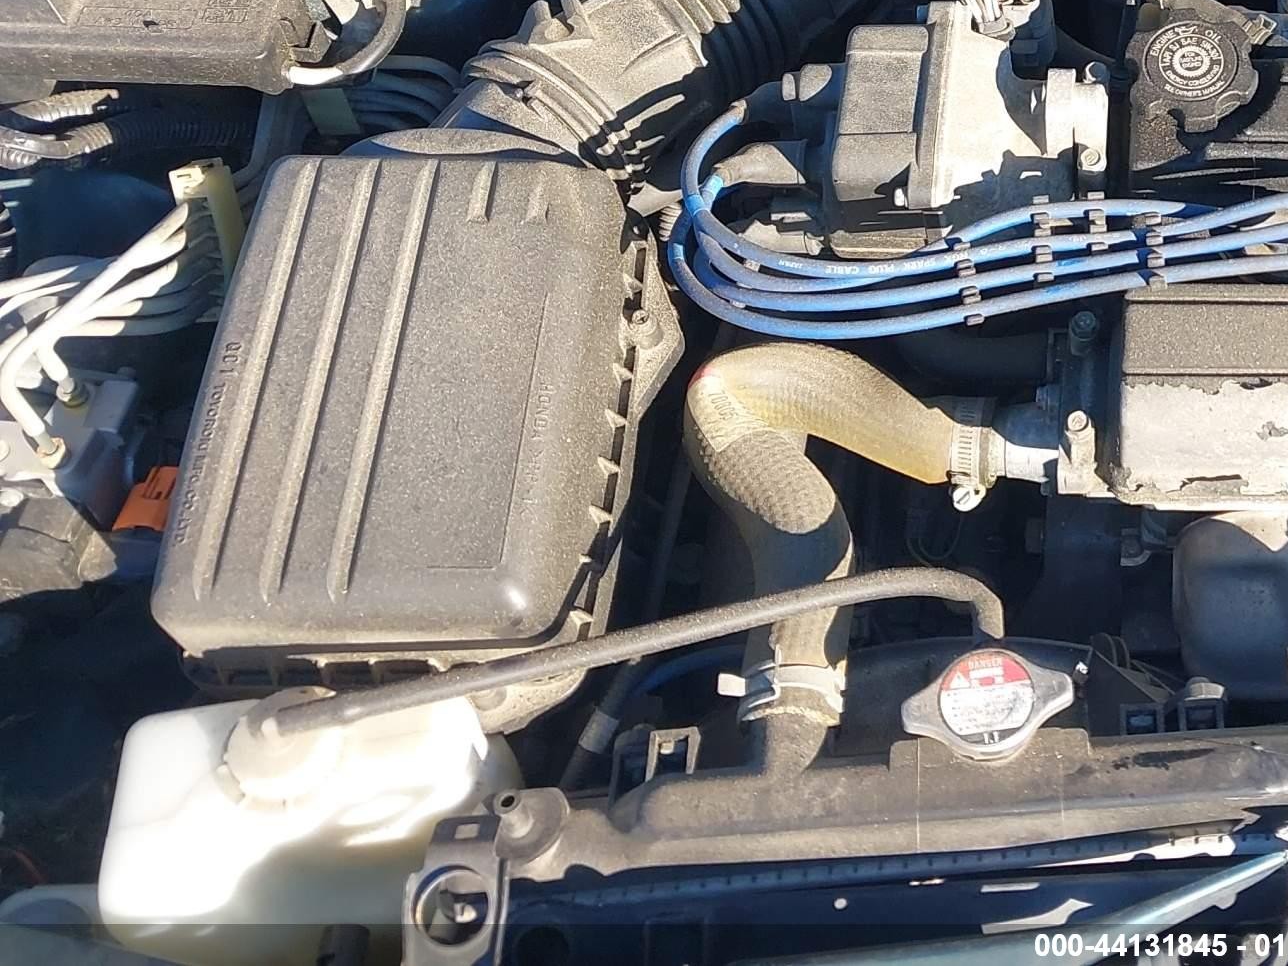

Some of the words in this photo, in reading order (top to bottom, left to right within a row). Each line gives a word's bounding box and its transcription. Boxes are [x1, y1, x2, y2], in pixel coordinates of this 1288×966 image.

[1150, 30, 1177, 57] ENGINE
[1204, 29, 1223, 44] OIL
[902, 255, 937, 269] SPARK
[825, 265, 859, 275] CABLE
[867, 263, 895, 275] PLUG
[531, 383, 557, 442] HONDA
[967, 656, 1003, 669] DANGER
